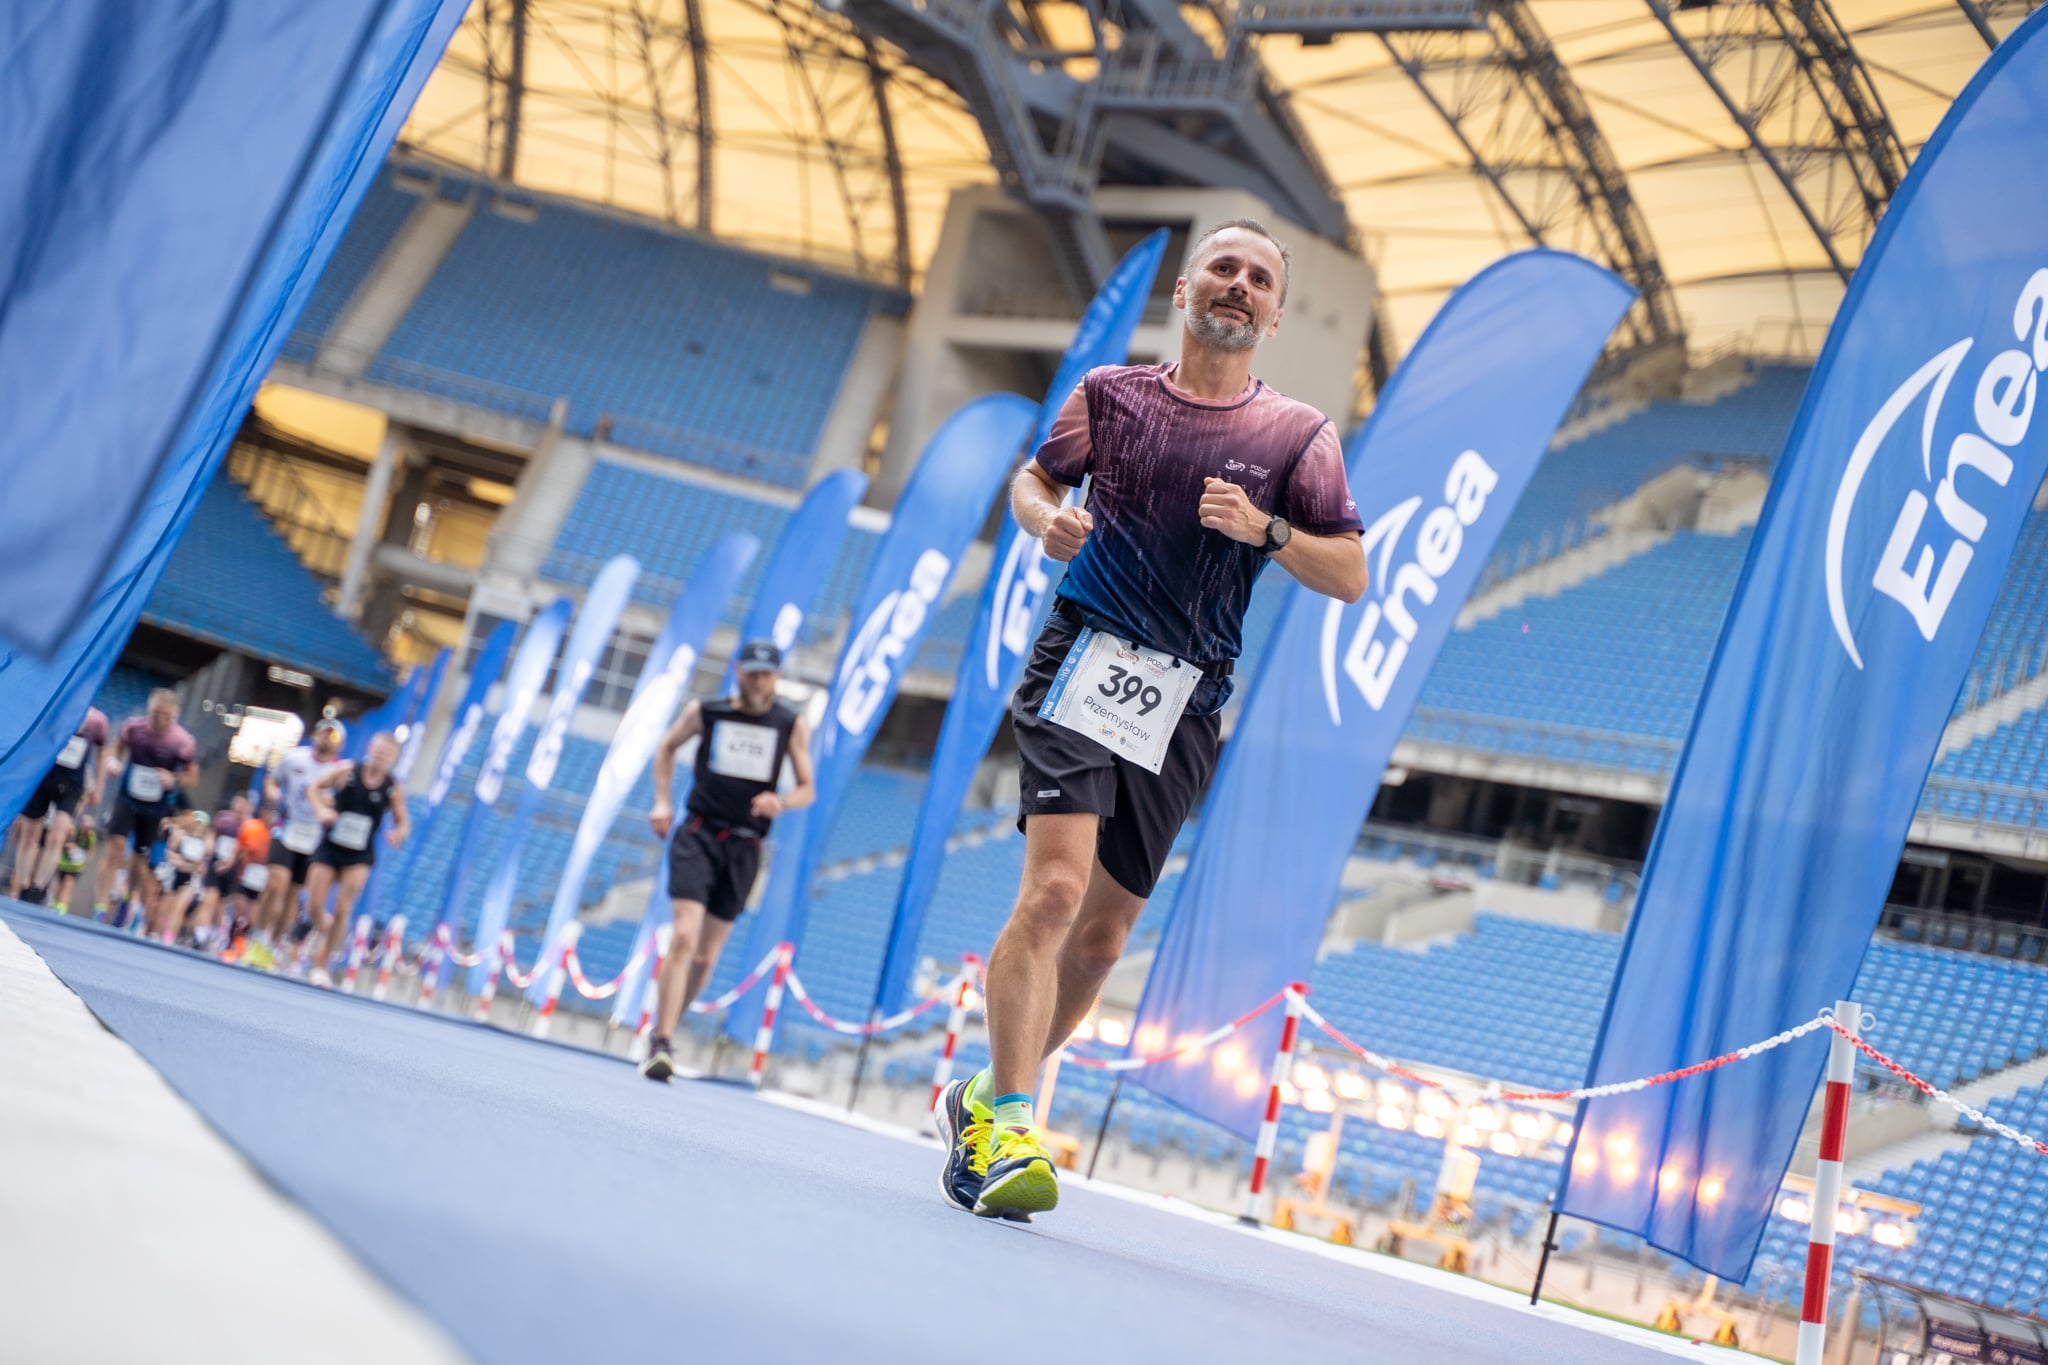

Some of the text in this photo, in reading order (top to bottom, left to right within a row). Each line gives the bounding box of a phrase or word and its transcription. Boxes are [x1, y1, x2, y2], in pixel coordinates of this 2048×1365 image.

[1343, 449, 1499, 711] Enea
[1097, 664, 1162, 717] 399
[1083, 695, 1151, 742] Przemysław
